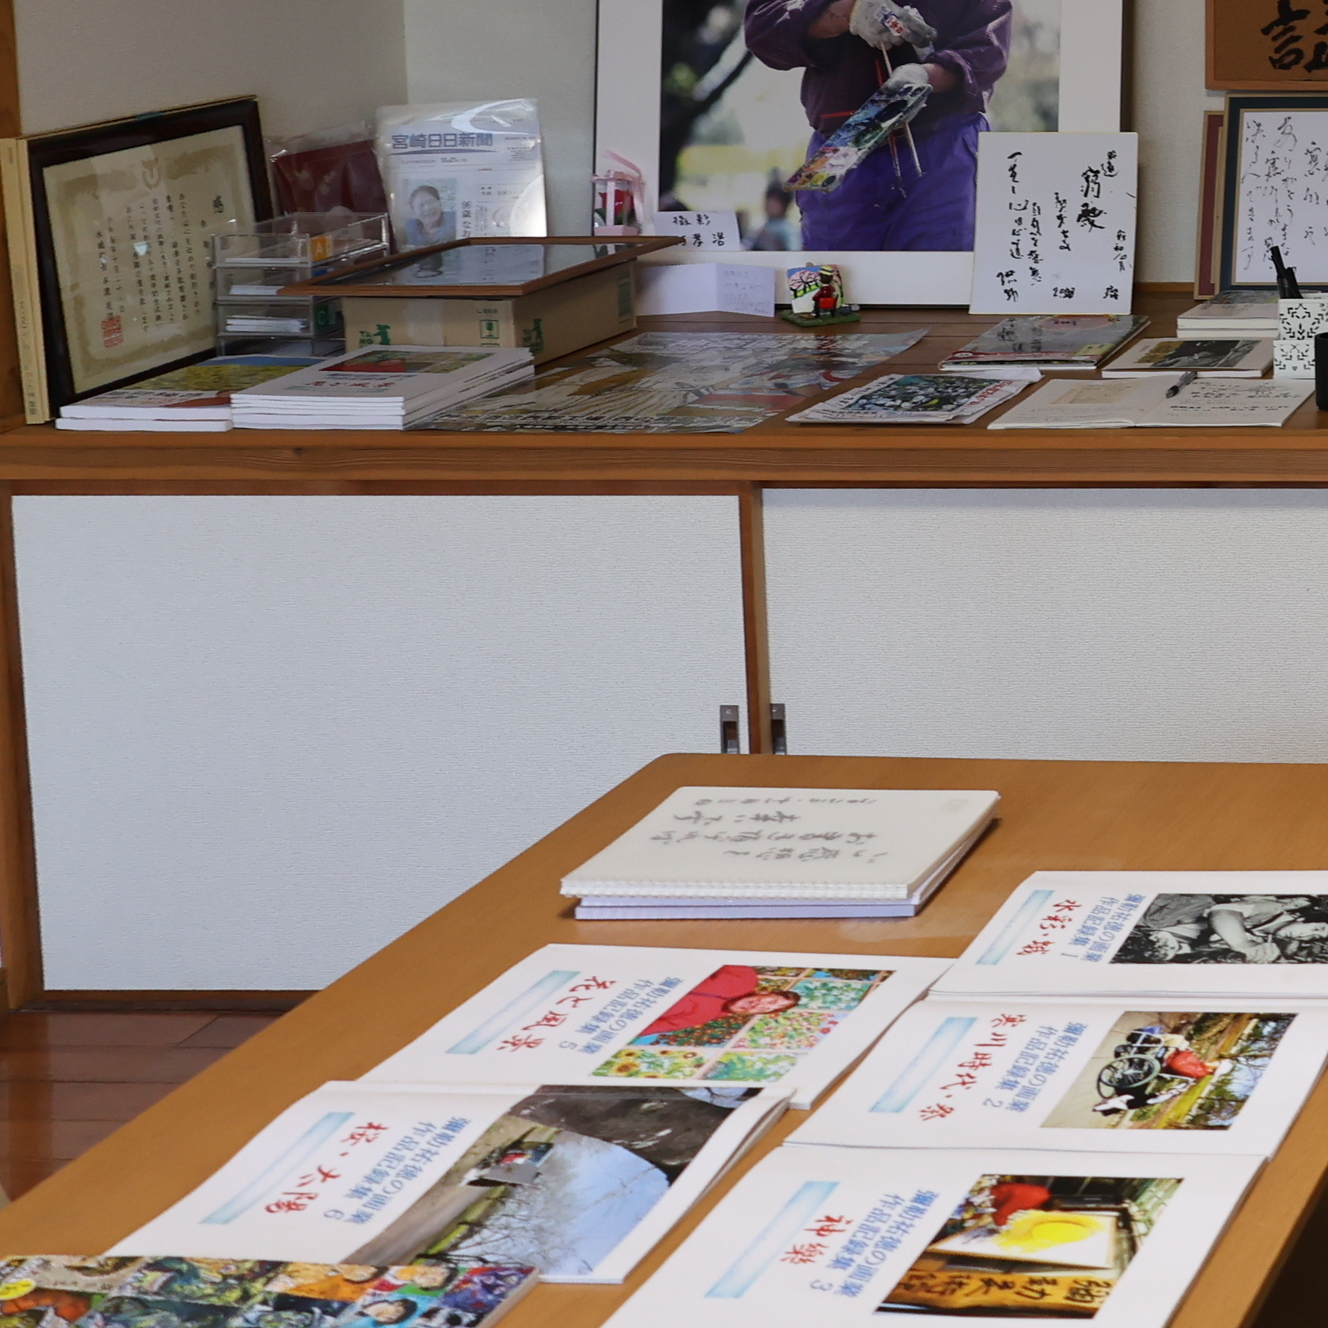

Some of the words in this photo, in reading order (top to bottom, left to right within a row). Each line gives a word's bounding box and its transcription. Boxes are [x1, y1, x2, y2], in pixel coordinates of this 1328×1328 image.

[391, 132, 494, 150] 宮崎日日新聞
[1070, 896, 1120, 947] 作品記録集
[1060, 951, 1079, 959] 1
[497, 975, 617, 1052] 花と風景
[574, 979, 655, 1036] 作品記録集
[557, 1040, 579, 1050] 5
[996, 1025, 1060, 1092] 作品記録集
[983, 1097, 1004, 1109] 2
[342, 1120, 437, 1200] 作品記録集
[322, 1207, 345, 1220] 6
[825, 1192, 906, 1271] 作品記録集
[810, 1279, 835, 1292] 3
